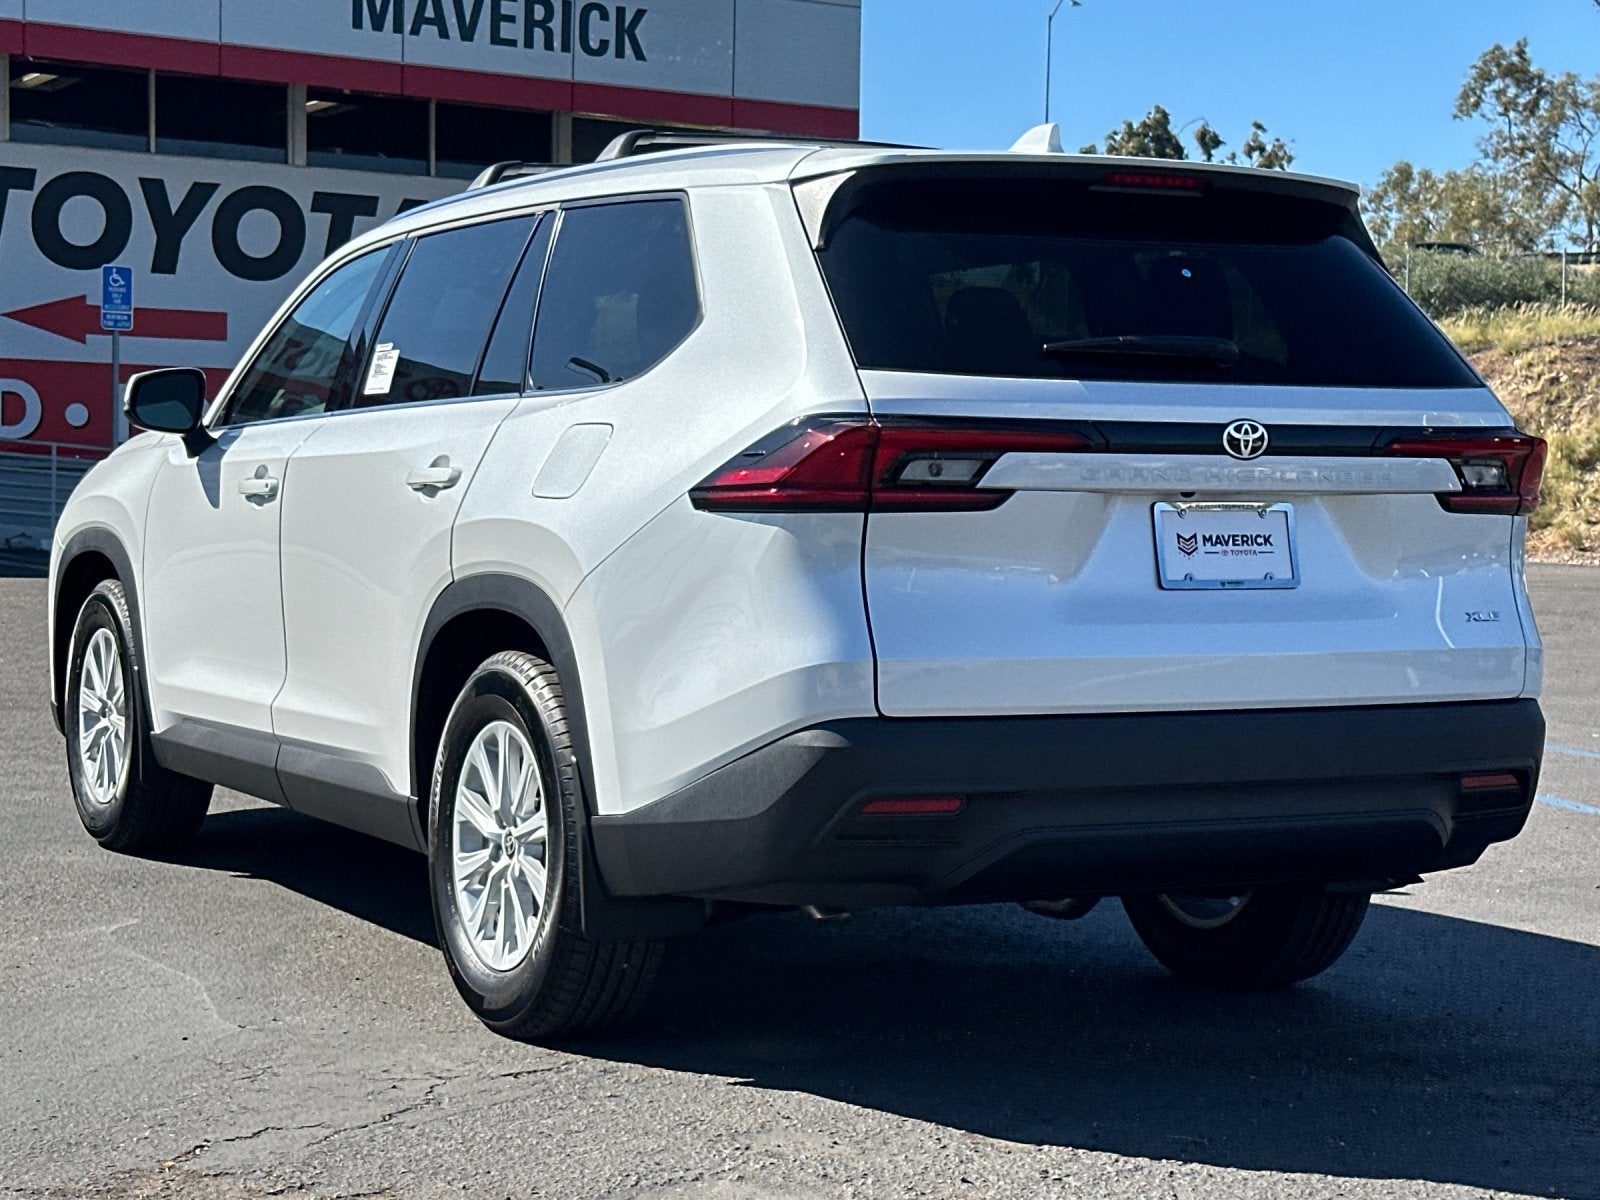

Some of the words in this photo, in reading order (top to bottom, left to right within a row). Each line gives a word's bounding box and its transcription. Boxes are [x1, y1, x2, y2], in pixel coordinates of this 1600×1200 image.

[351, 0, 648, 62] MAVERICK
[0, 165, 431, 282] OYOT
[1202, 534, 1273, 546] MAVERICK
[1464, 611, 1499, 622] XLE
